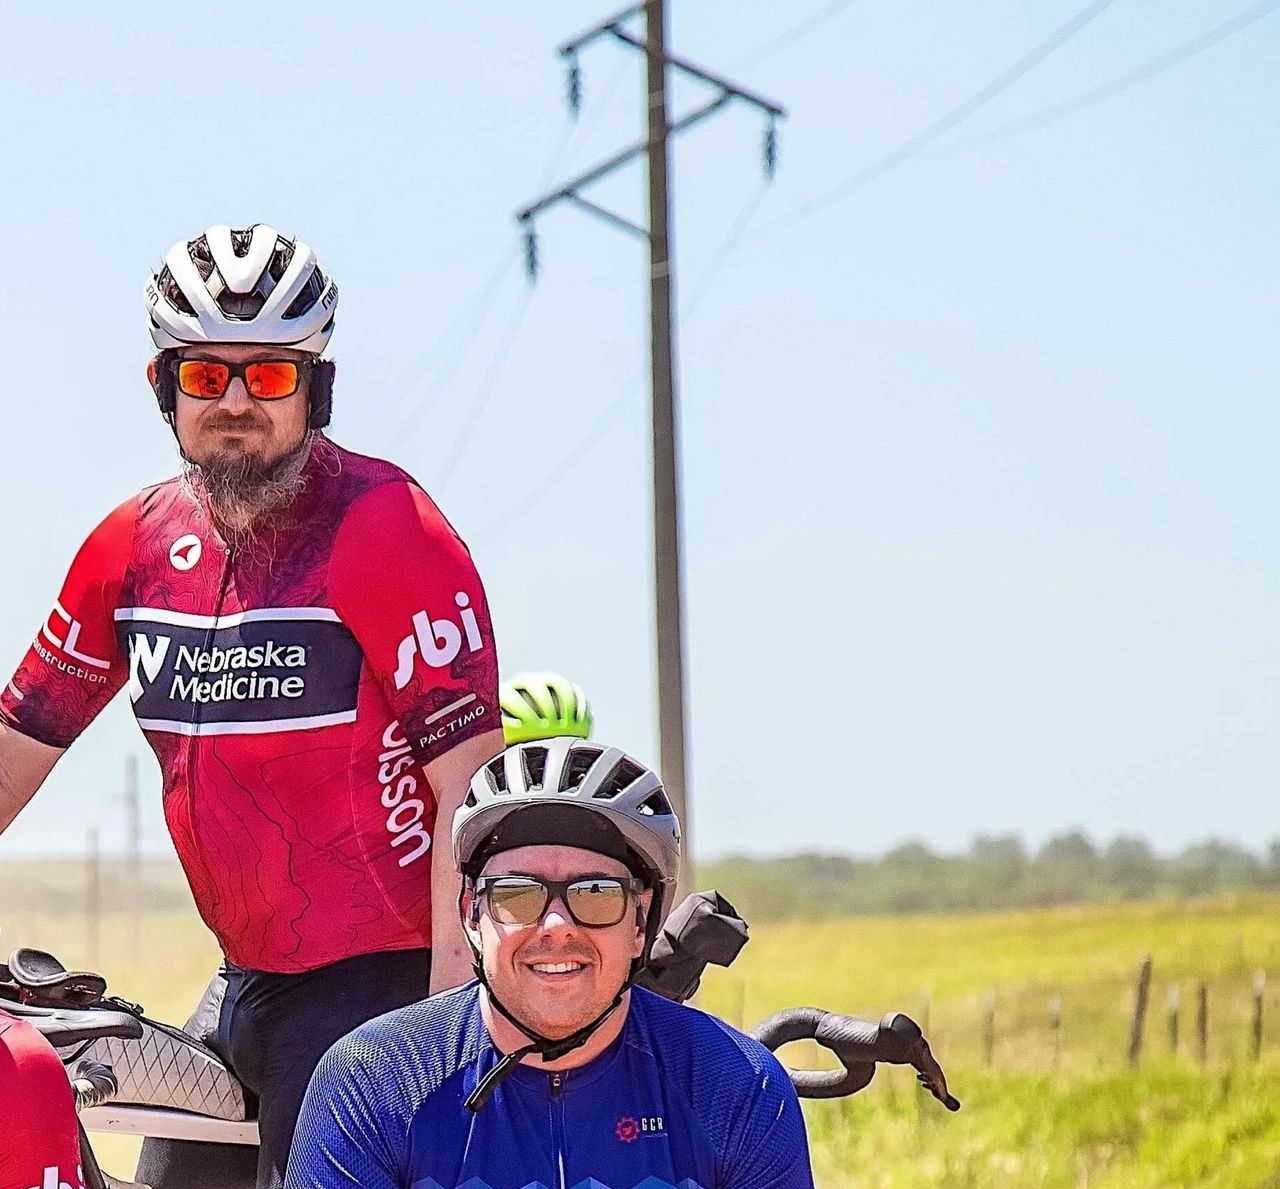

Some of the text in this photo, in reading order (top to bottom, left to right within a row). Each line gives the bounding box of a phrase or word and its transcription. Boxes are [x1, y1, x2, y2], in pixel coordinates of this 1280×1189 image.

[173, 640, 307, 673] Nebraska
[394, 591, 483, 690] sbi
[169, 671, 305, 703] Medicine
[419, 705, 485, 748] PACTIMO
[641, 1117, 663, 1131] GCR
